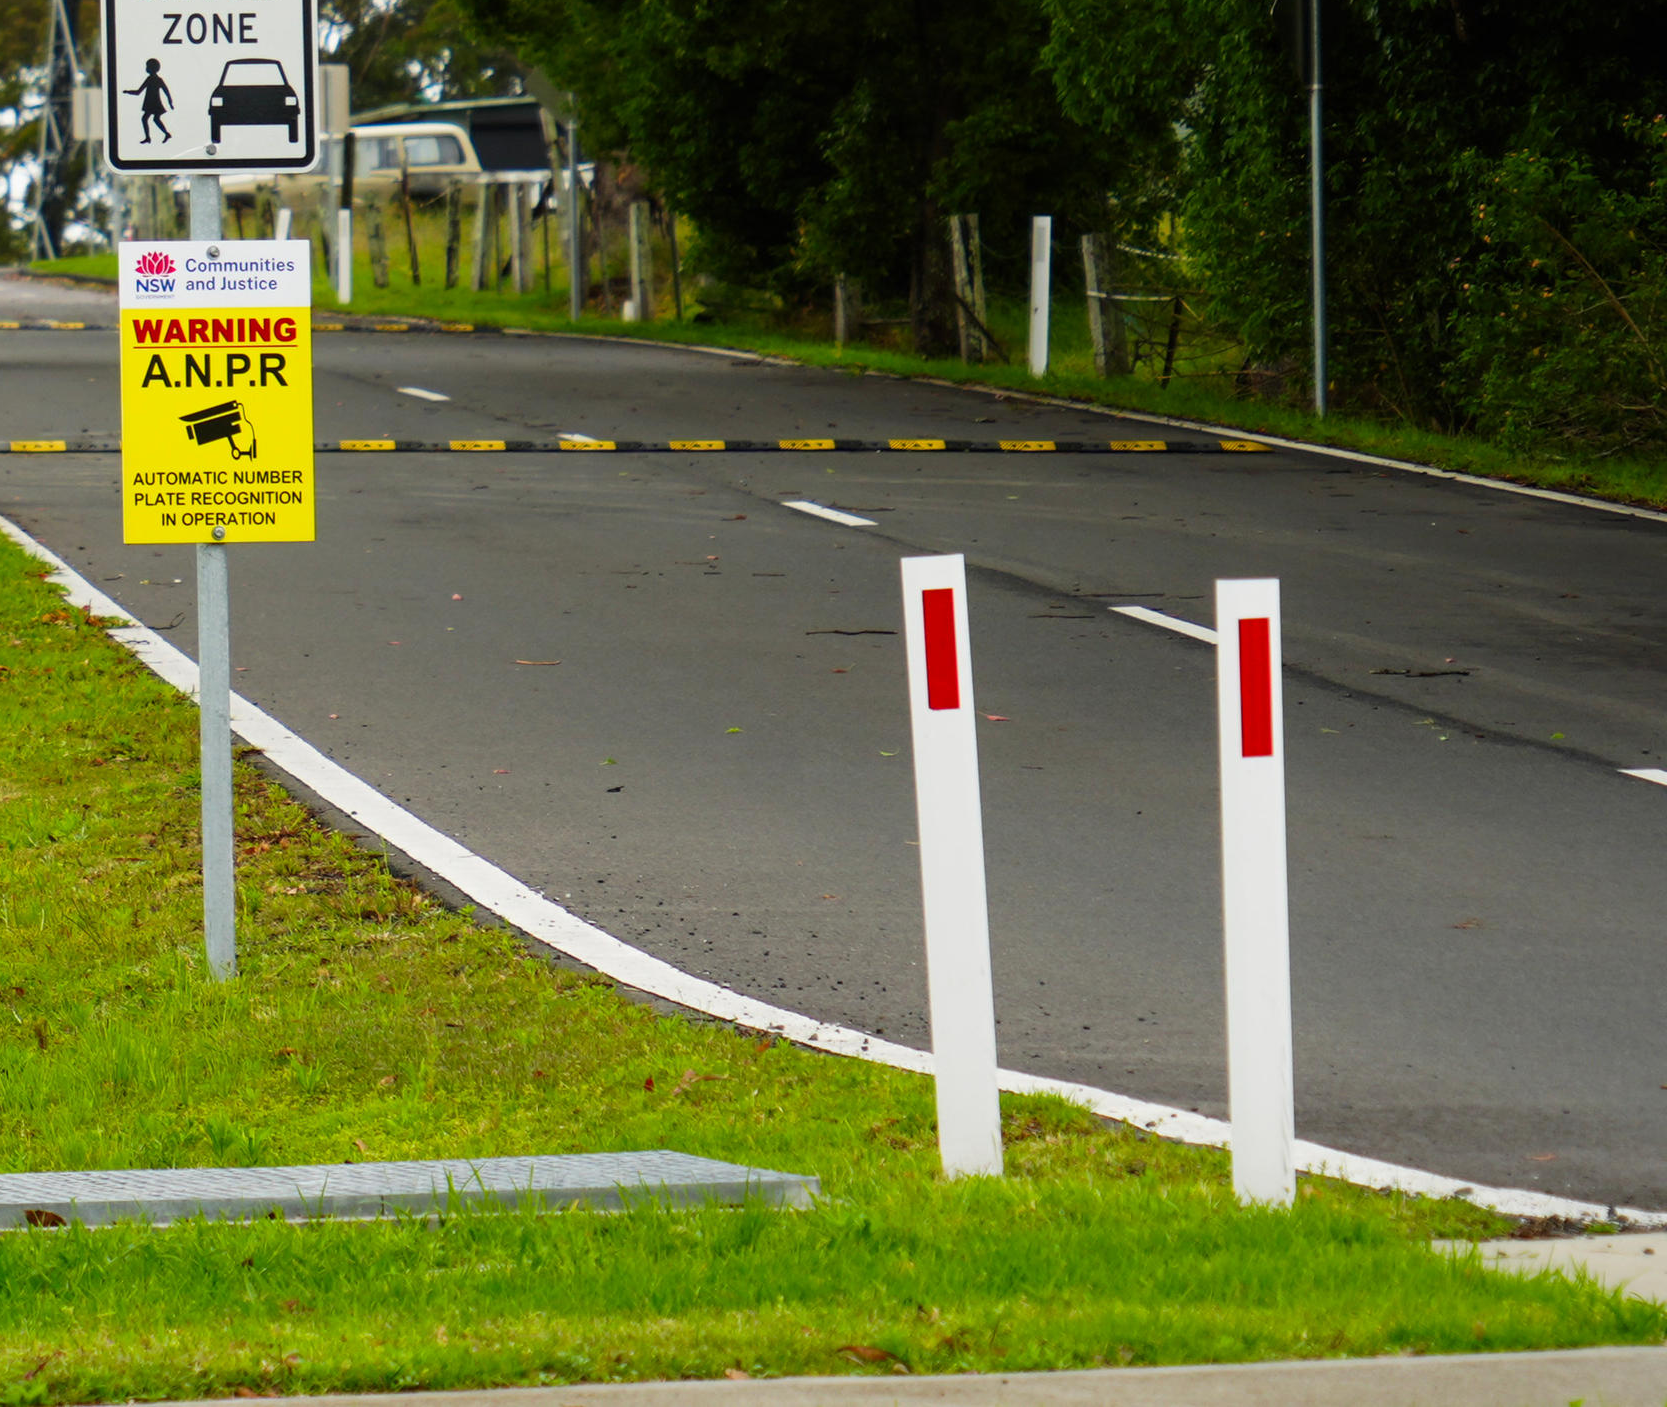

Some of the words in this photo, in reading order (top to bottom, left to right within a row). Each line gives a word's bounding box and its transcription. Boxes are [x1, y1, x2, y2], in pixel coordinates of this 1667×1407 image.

[162, 13, 258, 45] ZONE
[185, 258, 295, 273] Communities
[136, 278, 176, 293] NSW
[185, 277, 214, 291] and
[221, 276, 278, 291] Justice
[133, 317, 297, 344] WARNING
[142, 352, 288, 388] A.N.P.R
[133, 471, 228, 486] AUTOMATIC
[233, 470, 303, 485] NUMBER
[135, 492, 185, 506] PLATE
[191, 491, 303, 506] RECOGNITION
[161, 513, 176, 526] IN
[182, 512, 276, 526] OPERATION
